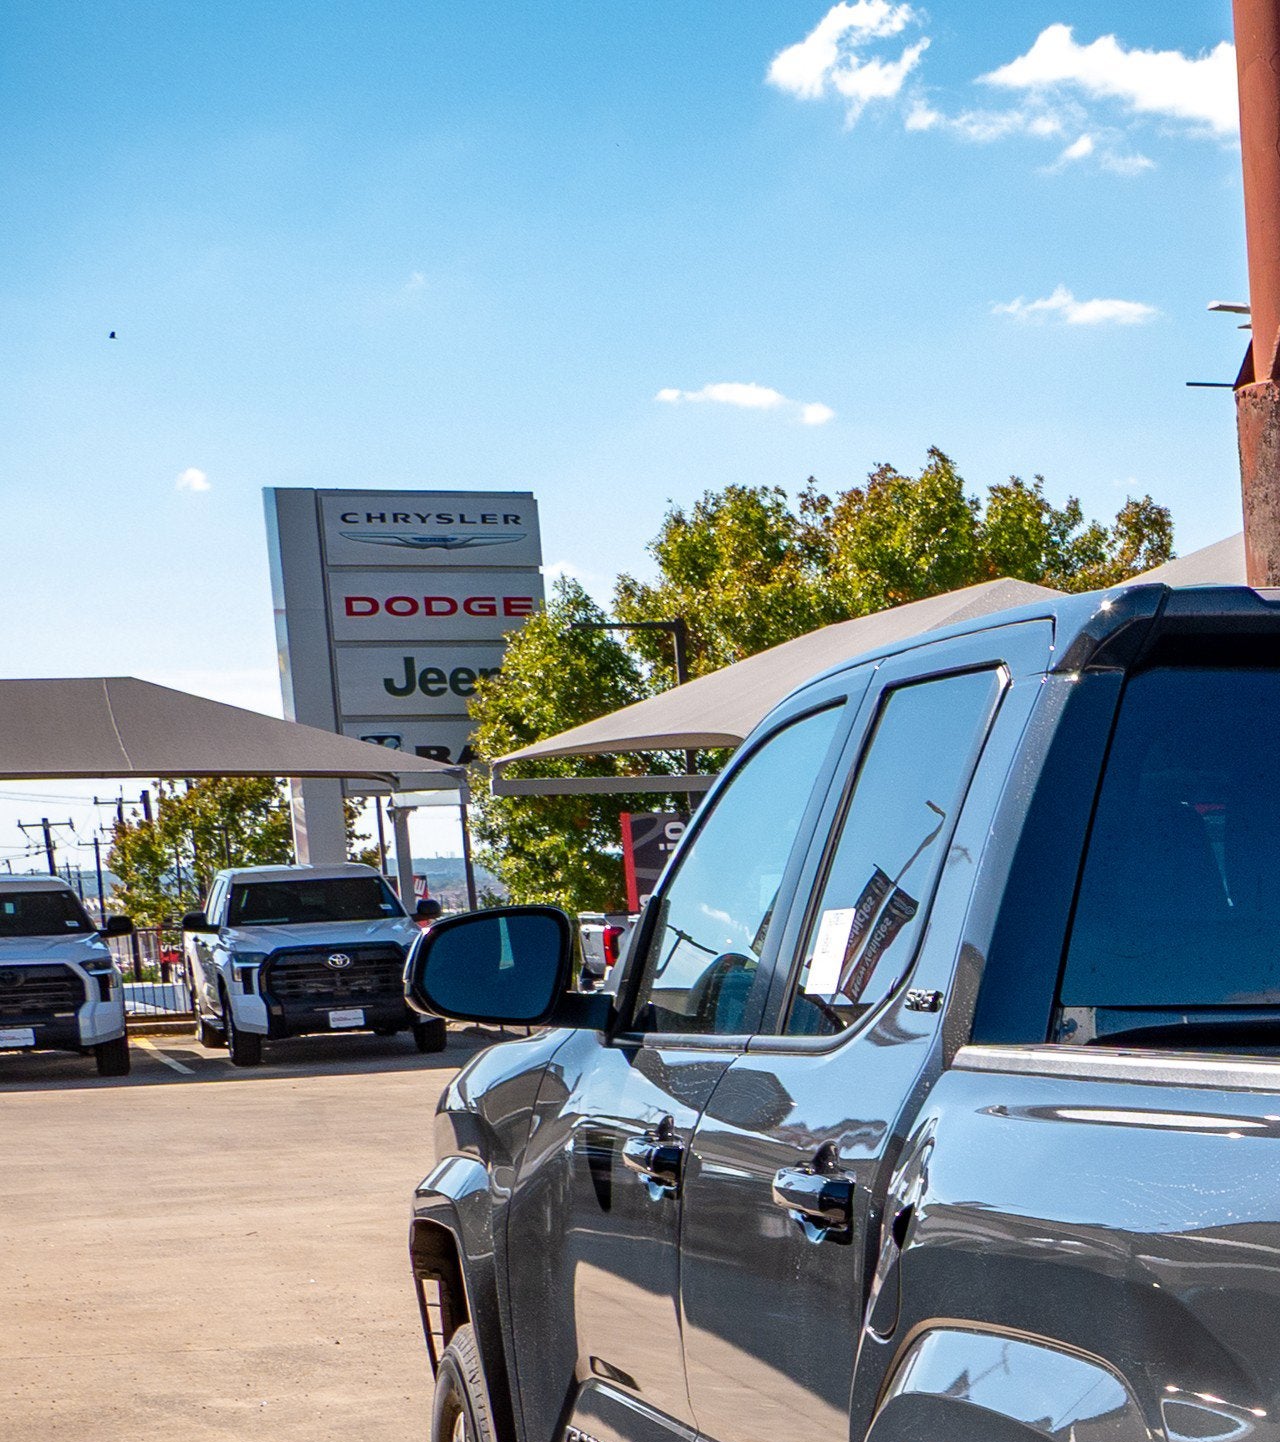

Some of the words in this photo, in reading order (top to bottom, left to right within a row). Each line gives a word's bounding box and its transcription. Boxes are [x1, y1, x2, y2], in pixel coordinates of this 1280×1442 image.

[340, 512, 522, 525] CHRYSLER
[344, 595, 533, 617] DODGE
[383, 656, 501, 697] Jee
